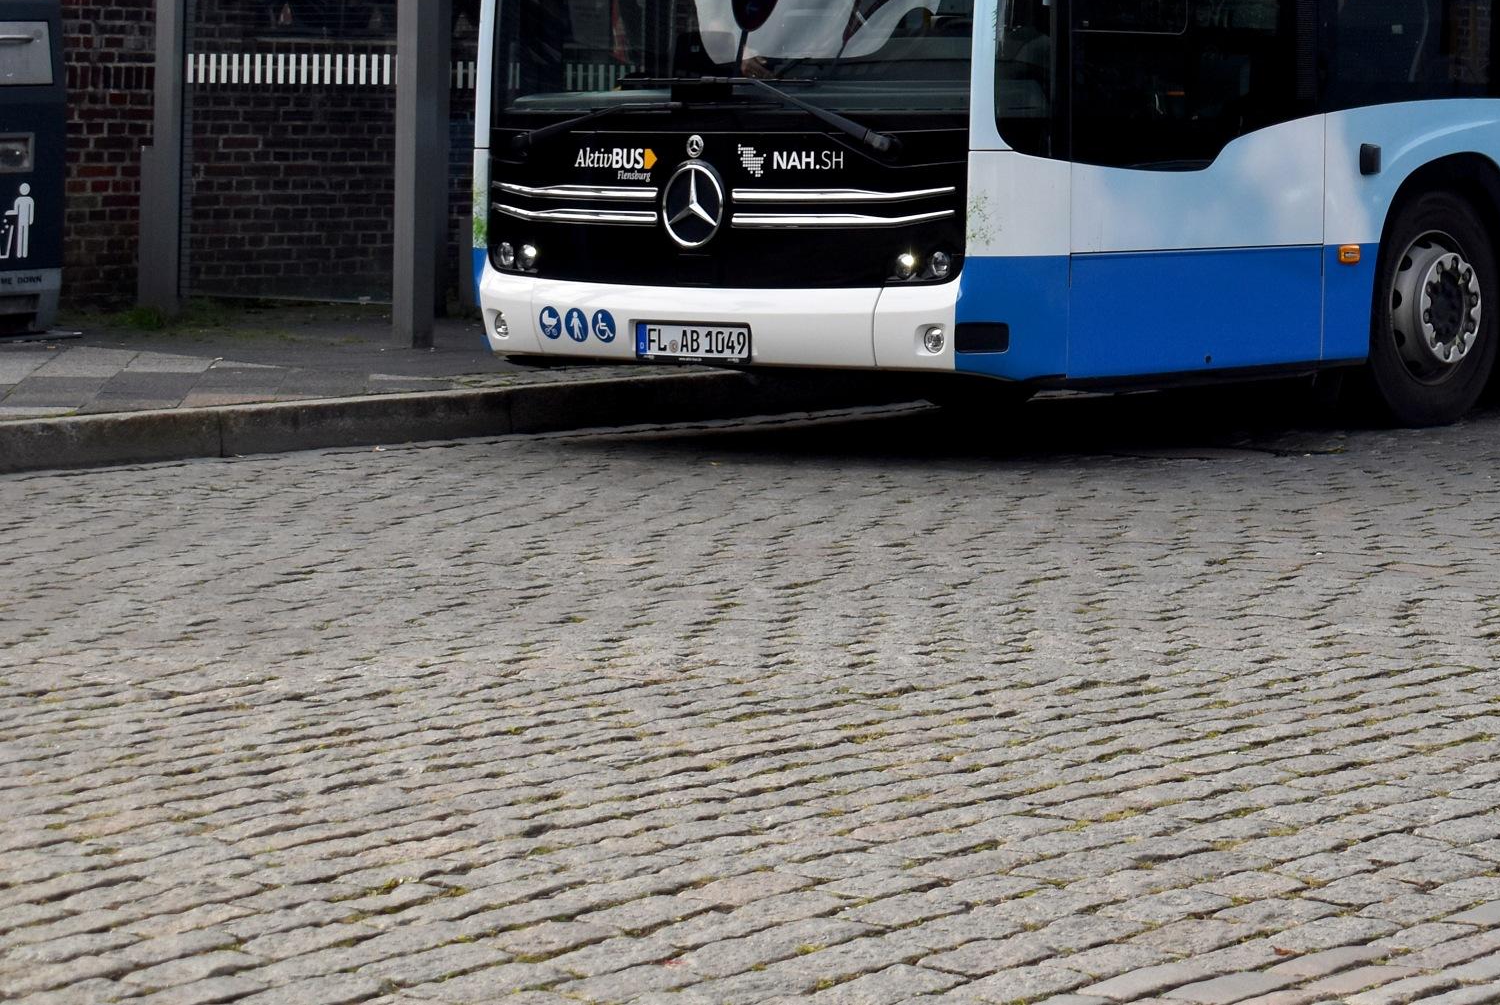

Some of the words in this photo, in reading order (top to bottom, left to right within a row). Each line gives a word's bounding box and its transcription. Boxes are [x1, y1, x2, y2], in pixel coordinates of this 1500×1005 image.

[574, 148, 644, 169] AktivBUS
[773, 151, 844, 170] NAH.SH
[617, 170, 651, 182] Flensburg
[647, 328, 667, 352] FL
[680, 329, 700, 353] AB
[704, 330, 747, 355] 1049
